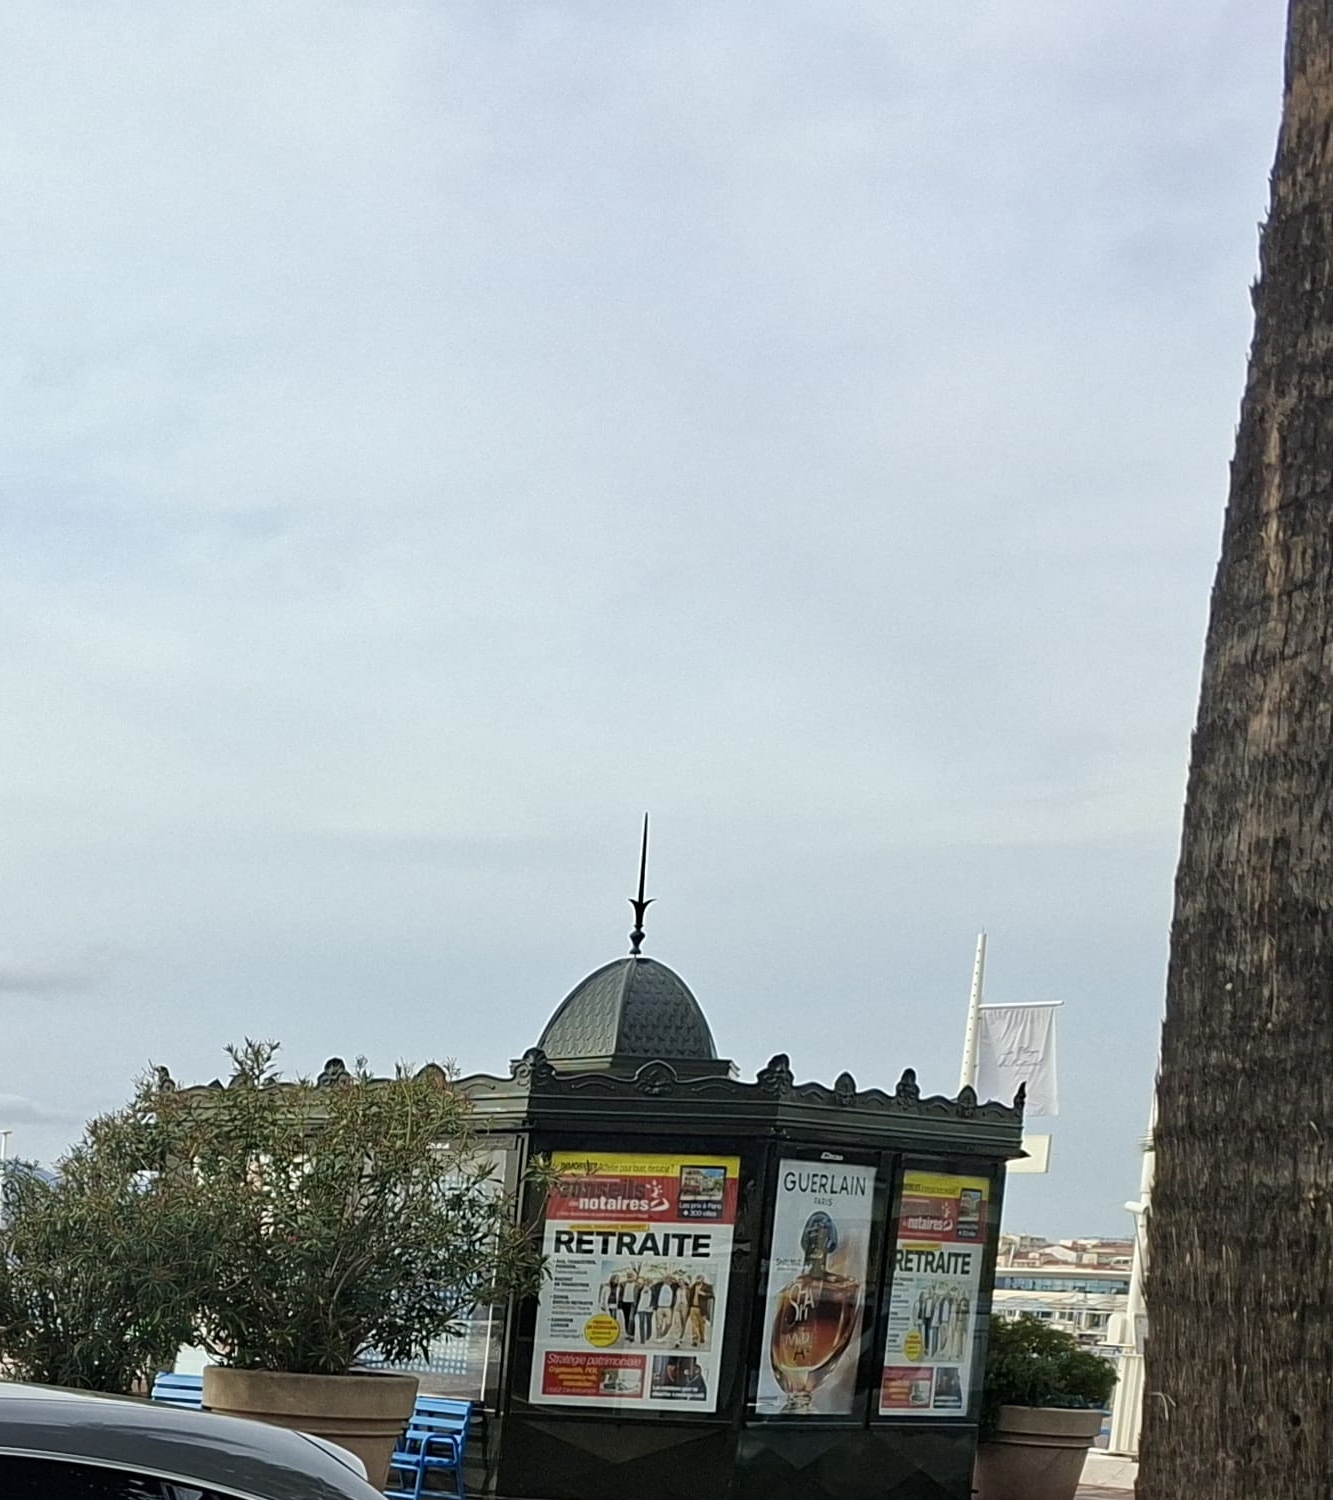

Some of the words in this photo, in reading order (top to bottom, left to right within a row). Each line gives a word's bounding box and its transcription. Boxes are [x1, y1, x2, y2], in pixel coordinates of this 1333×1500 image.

[783, 1171, 867, 1197] GUERLAIN
[578, 1196, 651, 1212] notaires
[907, 1216, 943, 1231] notaires
[553, 1229, 712, 1258] RETRAITE
[894, 1248, 973, 1275] RETRAITE
